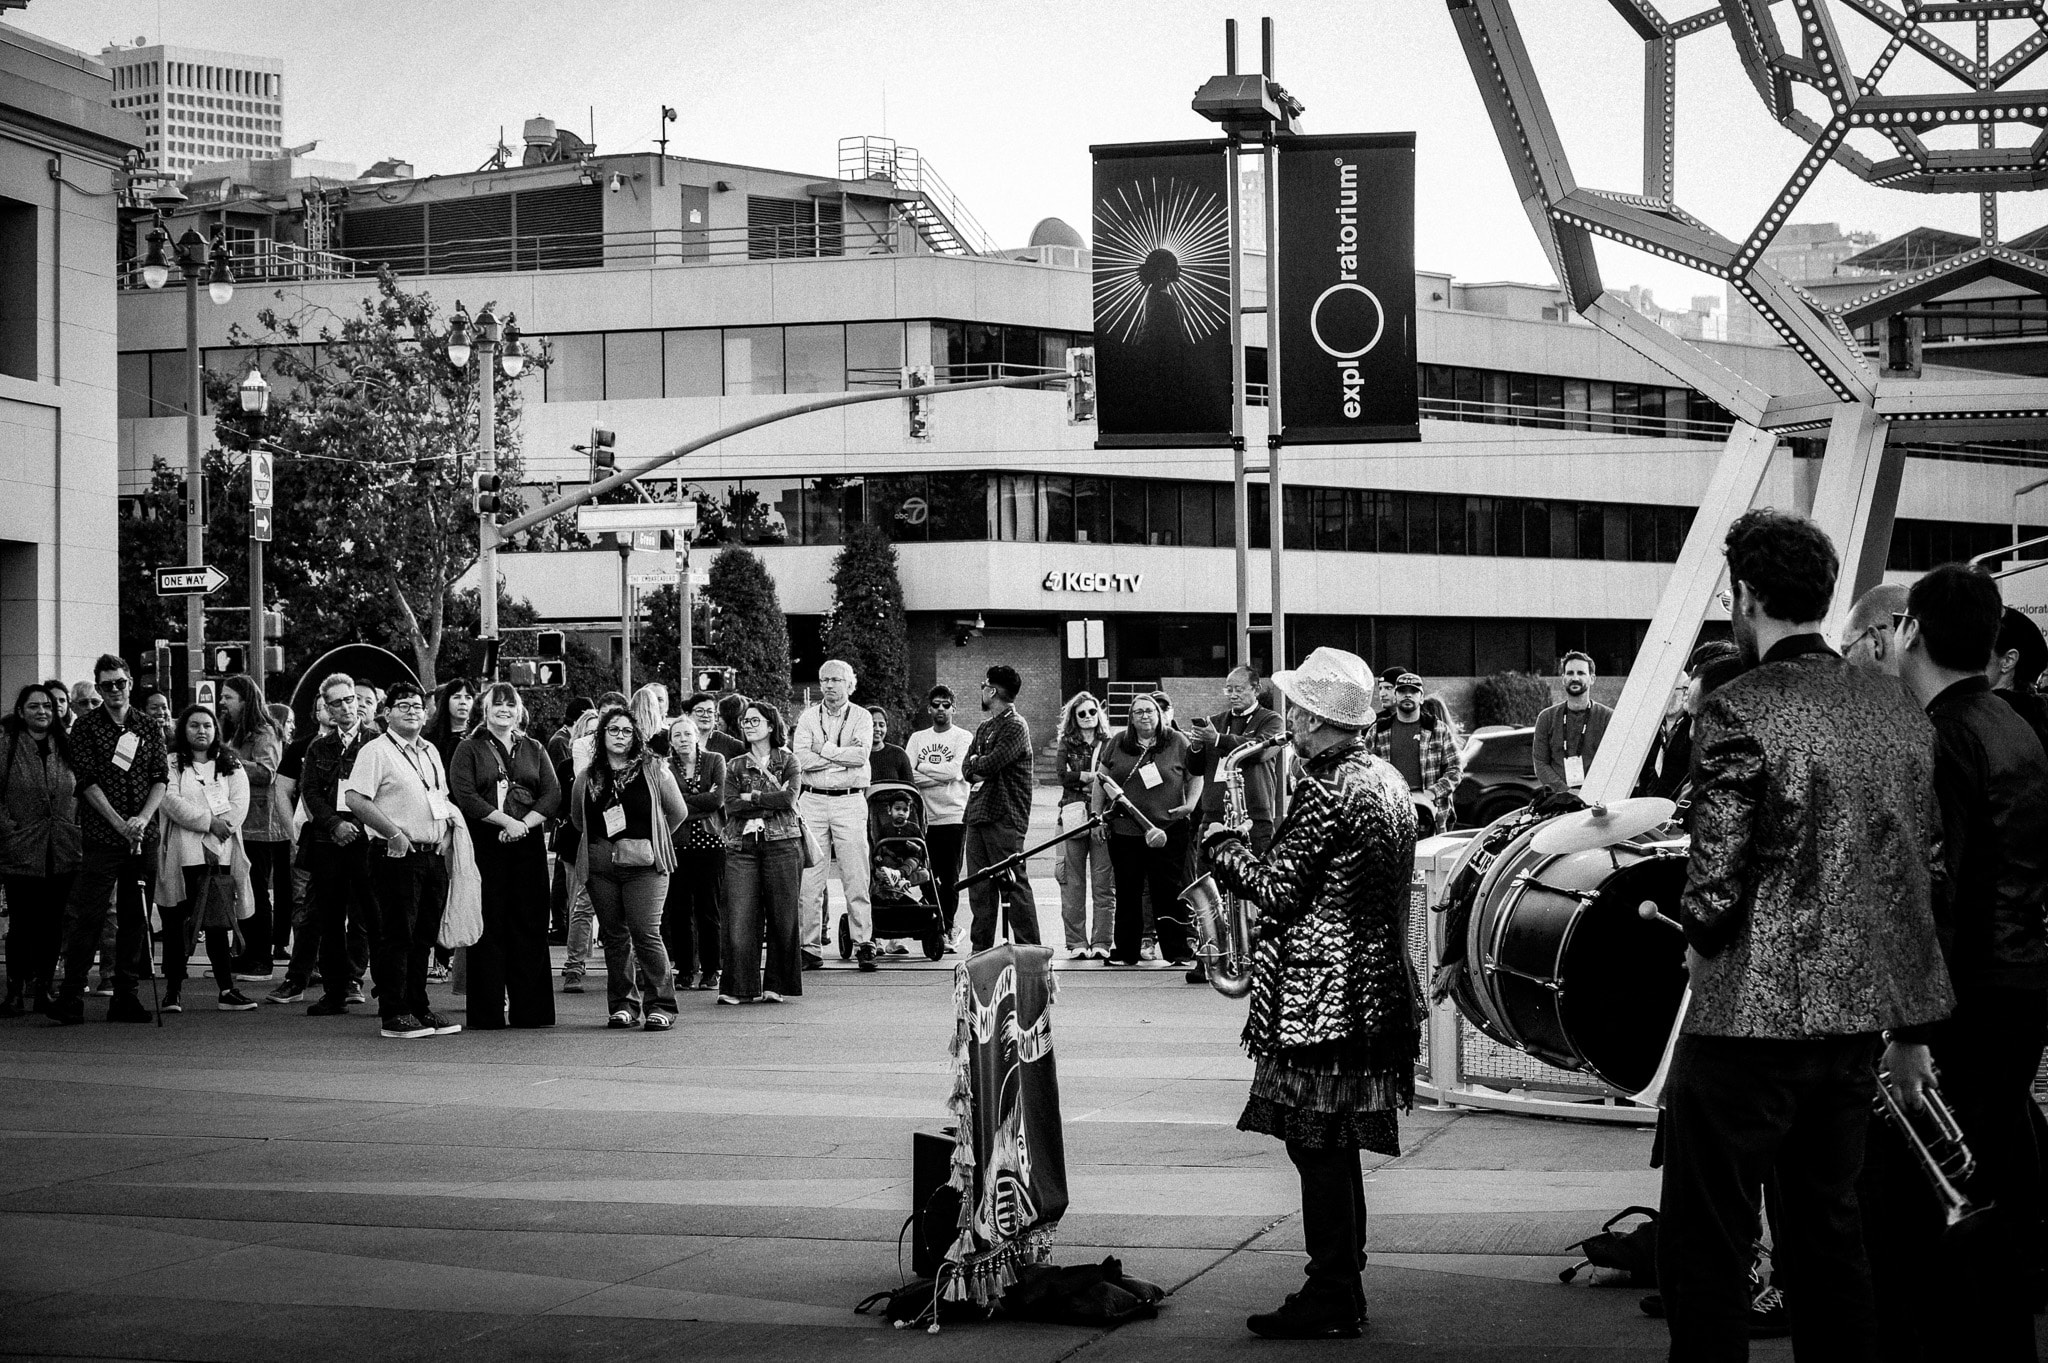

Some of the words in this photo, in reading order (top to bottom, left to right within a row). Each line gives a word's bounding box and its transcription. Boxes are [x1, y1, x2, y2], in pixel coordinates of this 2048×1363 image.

[164, 576, 183, 586] ONE
[186, 575, 205, 585] WAY
[918, 743, 954, 762] COLUMBIA
